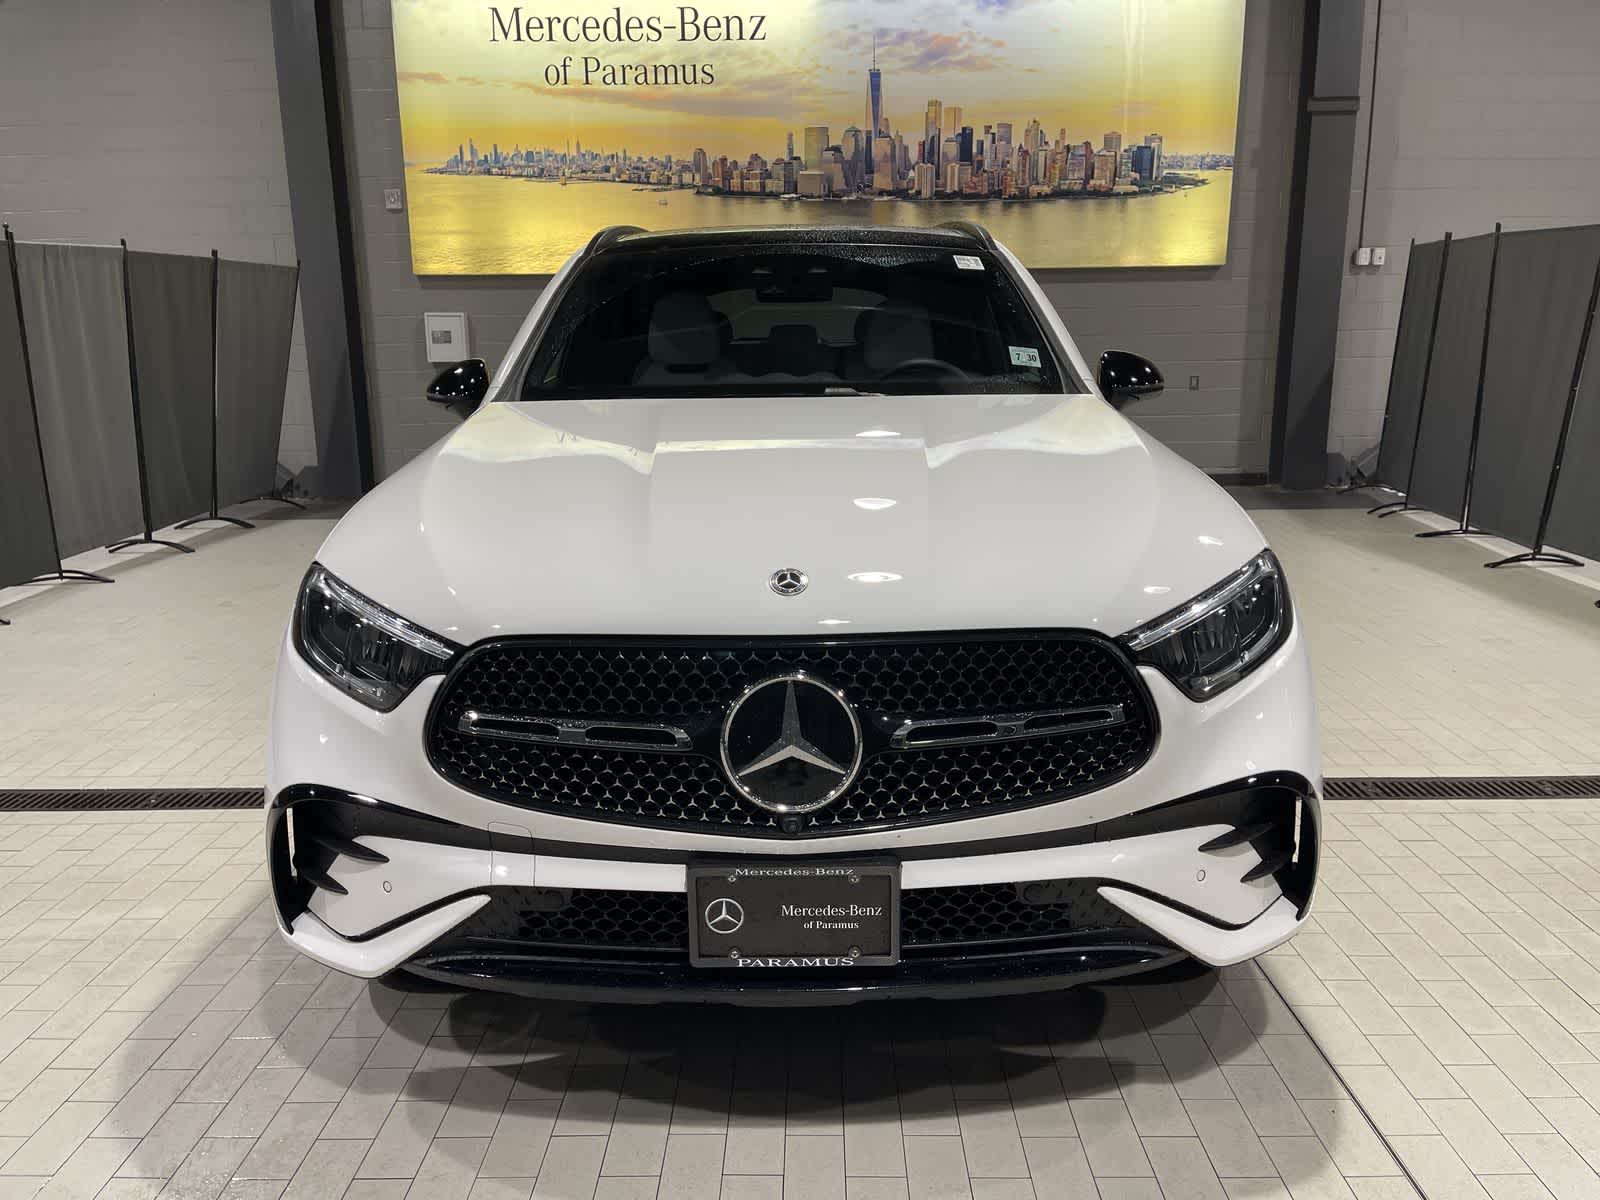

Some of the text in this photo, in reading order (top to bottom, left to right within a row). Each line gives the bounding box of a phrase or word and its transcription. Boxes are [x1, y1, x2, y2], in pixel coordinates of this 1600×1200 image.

[489, 6, 766, 42] Mercedes-Benz
[544, 55, 715, 87] of Paramus
[1016, 353, 1021, 361] 7
[735, 868, 855, 876] Mercedes-Benz
[781, 904, 882, 916] Mercedes-Benz
[803, 920, 859, 929] of Paramus
[738, 957, 854, 967] PARAMUS
